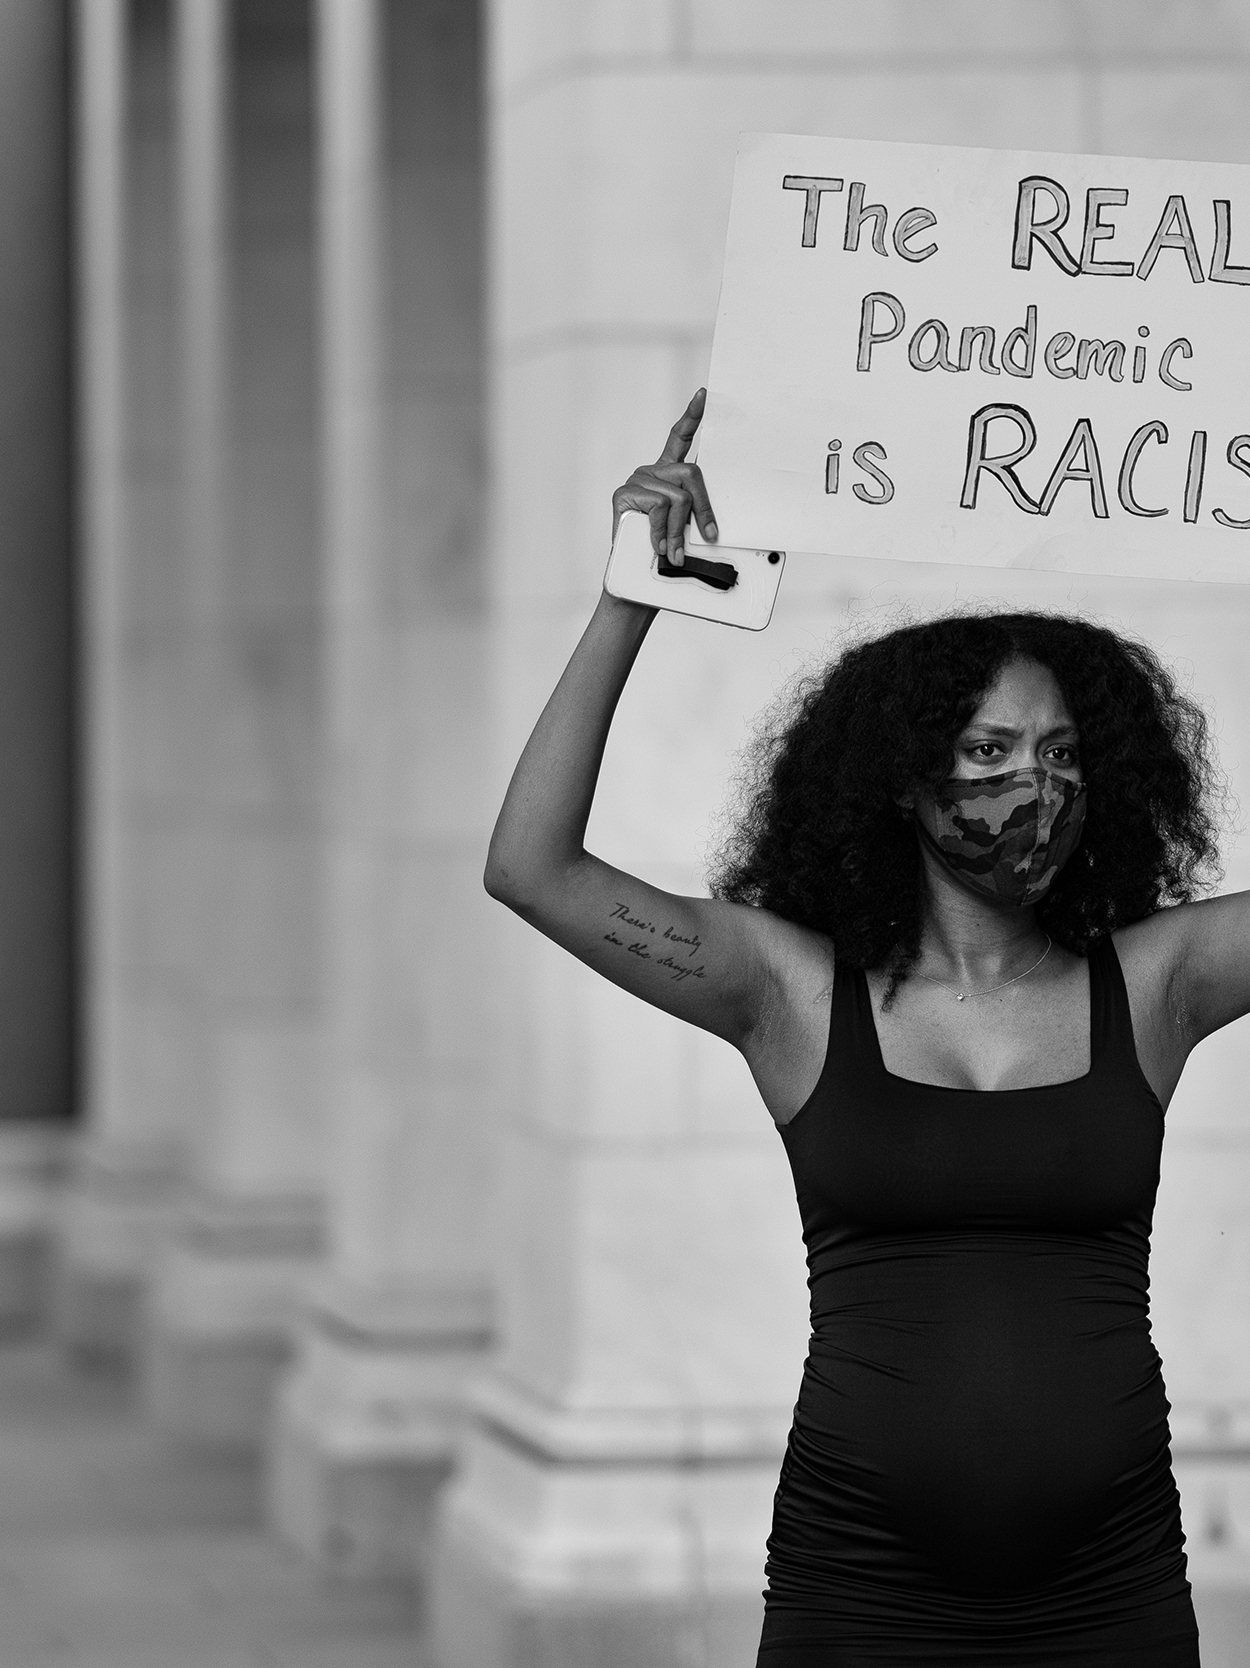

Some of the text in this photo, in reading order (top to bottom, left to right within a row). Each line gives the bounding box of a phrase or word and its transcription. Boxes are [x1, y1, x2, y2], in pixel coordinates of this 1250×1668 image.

[782, 174, 939, 263] The
[855, 291, 1193, 392] Pandemic
[824, 438, 895, 506] is
[603, 931, 706, 982] in the struggle
[608, 902, 702, 957] There's beauty
